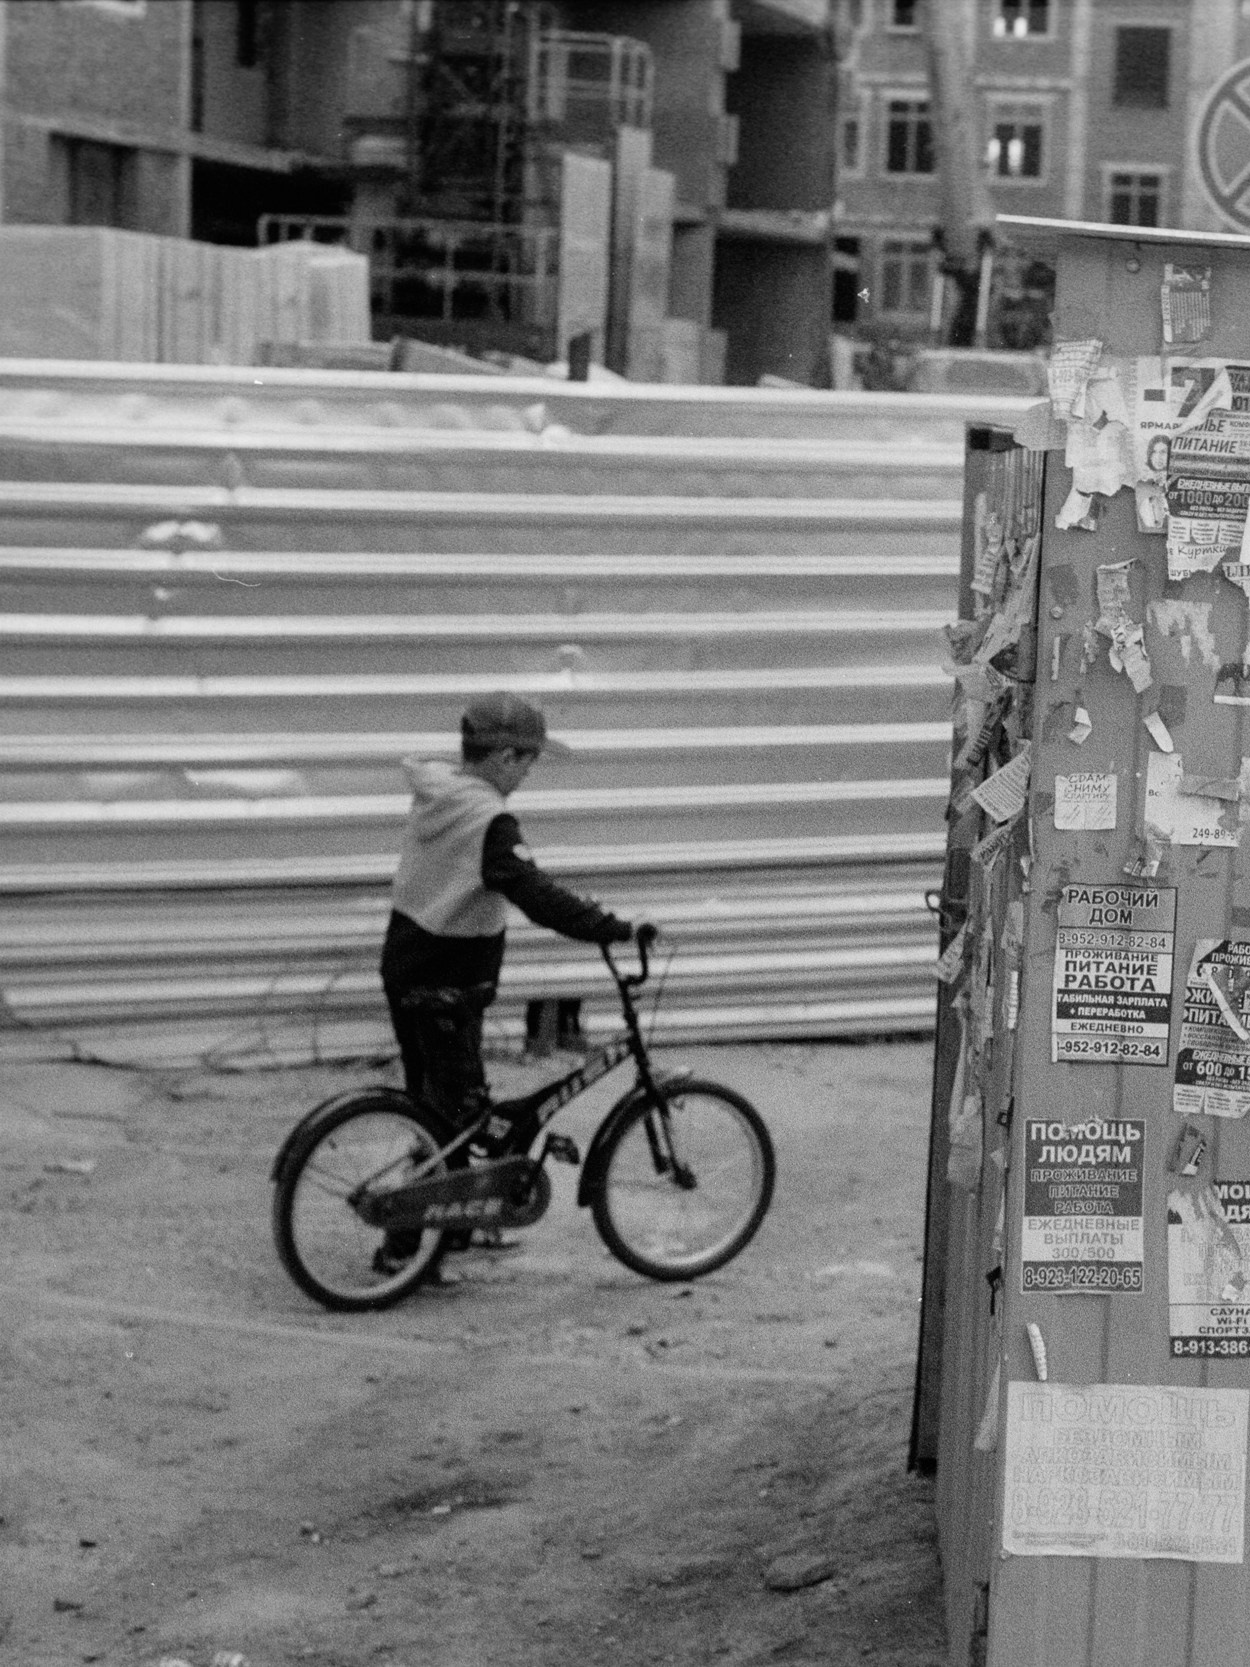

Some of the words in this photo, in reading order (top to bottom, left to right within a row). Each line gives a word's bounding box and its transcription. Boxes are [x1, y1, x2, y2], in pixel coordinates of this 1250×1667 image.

[1173, 437, 1238, 454] ПИТАНИЕ
[1180, 491, 1212, 505] 1000
[1067, 889, 1159, 908] РАБОЧИЙ
[1089, 909, 1133, 926] ДОМ
[1065, 950, 1159, 963] ПРОЖИВАНИЕ
[1064, 961, 1158, 976] ПИТАНИЕ
[1063, 975, 1157, 992] РАБОТА
[1057, 993, 1115, 1005] ТАБИЛЬНАЯ
[1117, 996, 1168, 1008] ЗАРПЛАТА
[1077, 1007, 1146, 1019] ПЕРЕРАБОТКА
[1070, 1022, 1144, 1035] ЕЖЕДНЕВНО
[1057, 1041, 1161, 1057] -952-912-82-84
[1196, 1061, 1222, 1077] 600
[1030, 1122, 1141, 1143] ПОМОЩЬ
[1038, 1145, 1131, 1166] ЛЮДЯМ
[1030, 1169, 1138, 1183] ПРОЖИВАНИЕ
[1049, 1185, 1120, 1198] ПИТАНИЕ
[1054, 1201, 1115, 1215] РАБОТА
[1027, 1218, 1140, 1231] ЕЖЕДНЕВНЫЕ
[1043, 1233, 1125, 1246] ВЫПЛАТЫ
[1024, 1266, 1142, 1288] 8-923-122-20-65
